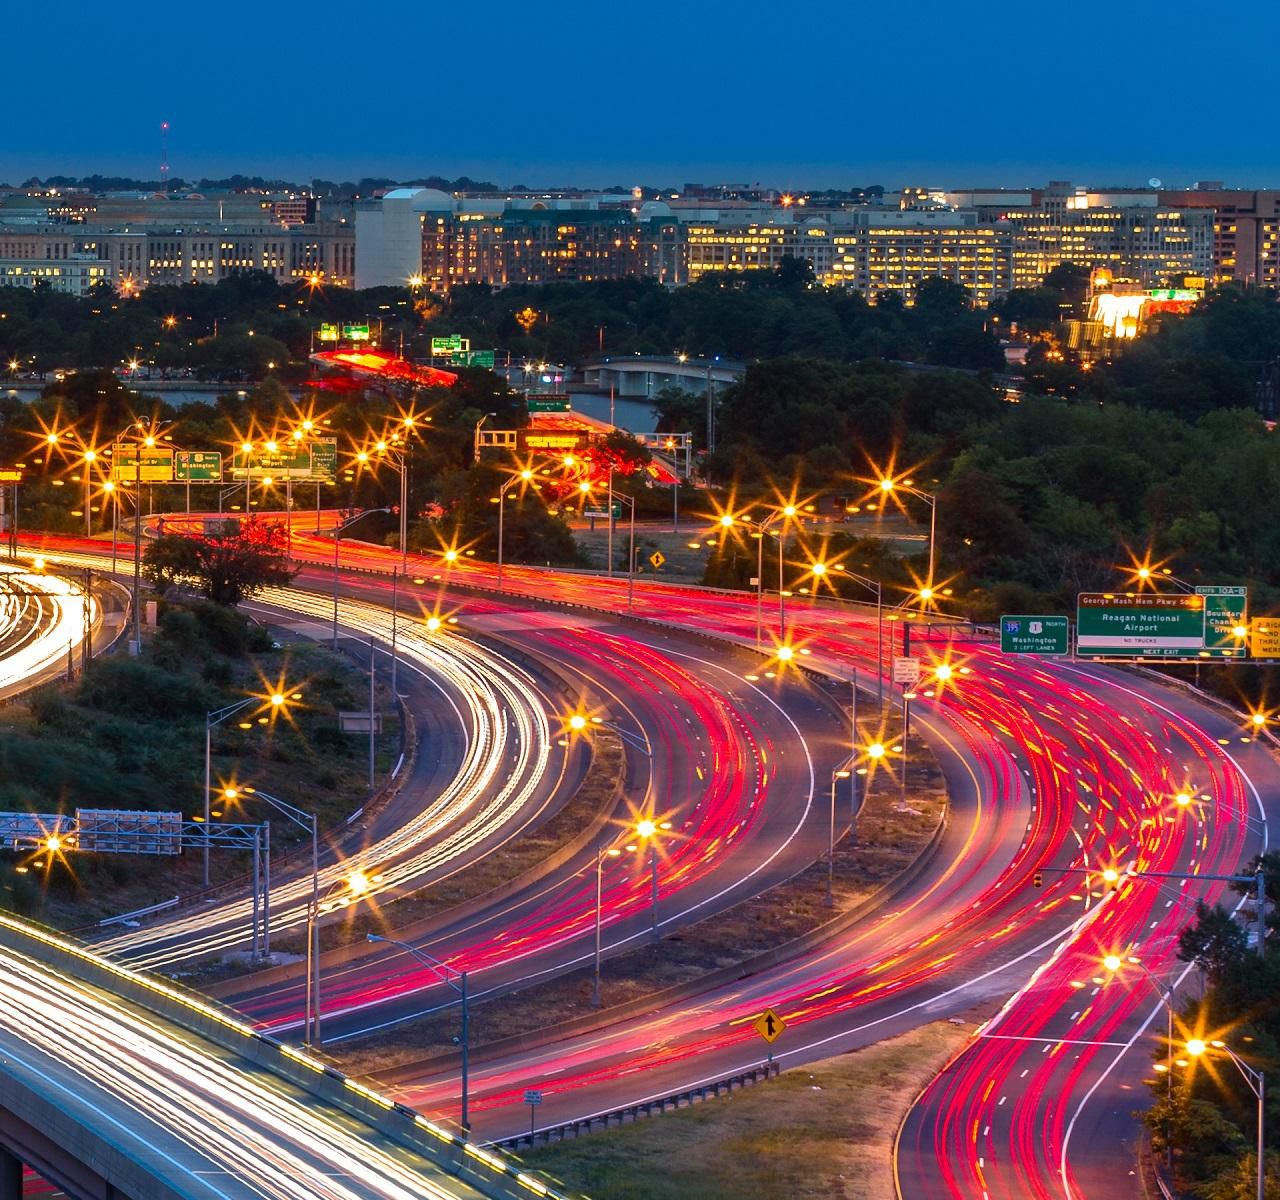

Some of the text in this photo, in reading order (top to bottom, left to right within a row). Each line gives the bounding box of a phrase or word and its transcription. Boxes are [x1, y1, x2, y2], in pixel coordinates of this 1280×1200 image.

[1102, 613, 1180, 623] Reagan National
[1124, 624, 1158, 632] Airport
[1012, 637, 1057, 645] Washington
